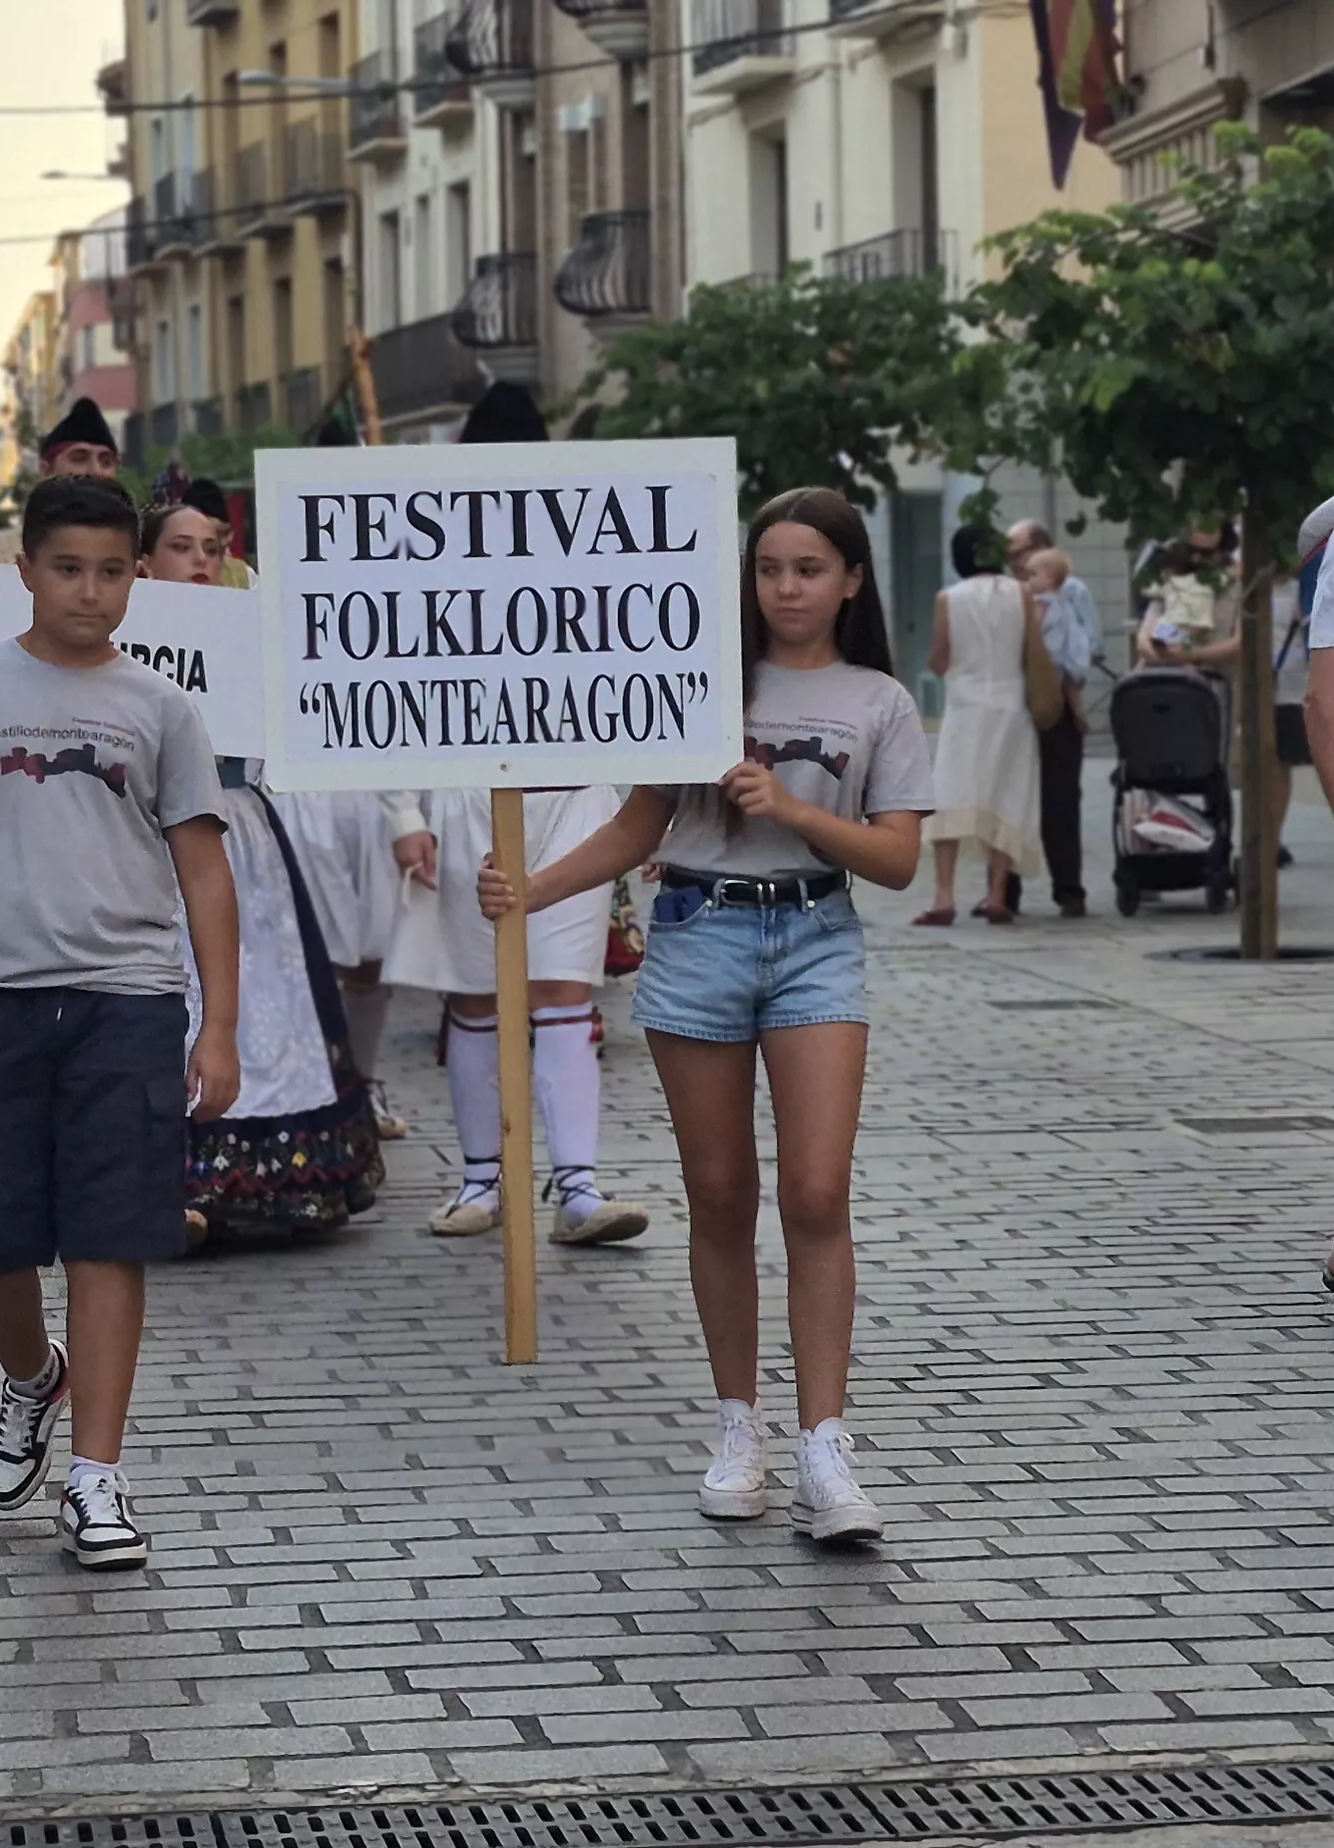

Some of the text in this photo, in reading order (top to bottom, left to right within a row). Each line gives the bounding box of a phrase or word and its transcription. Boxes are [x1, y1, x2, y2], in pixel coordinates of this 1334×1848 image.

[298, 485, 698, 562] FESTIVAL
[301, 581, 701, 660] FOLKLORICO
[299, 671, 708, 749] “MONTEARAGON”
